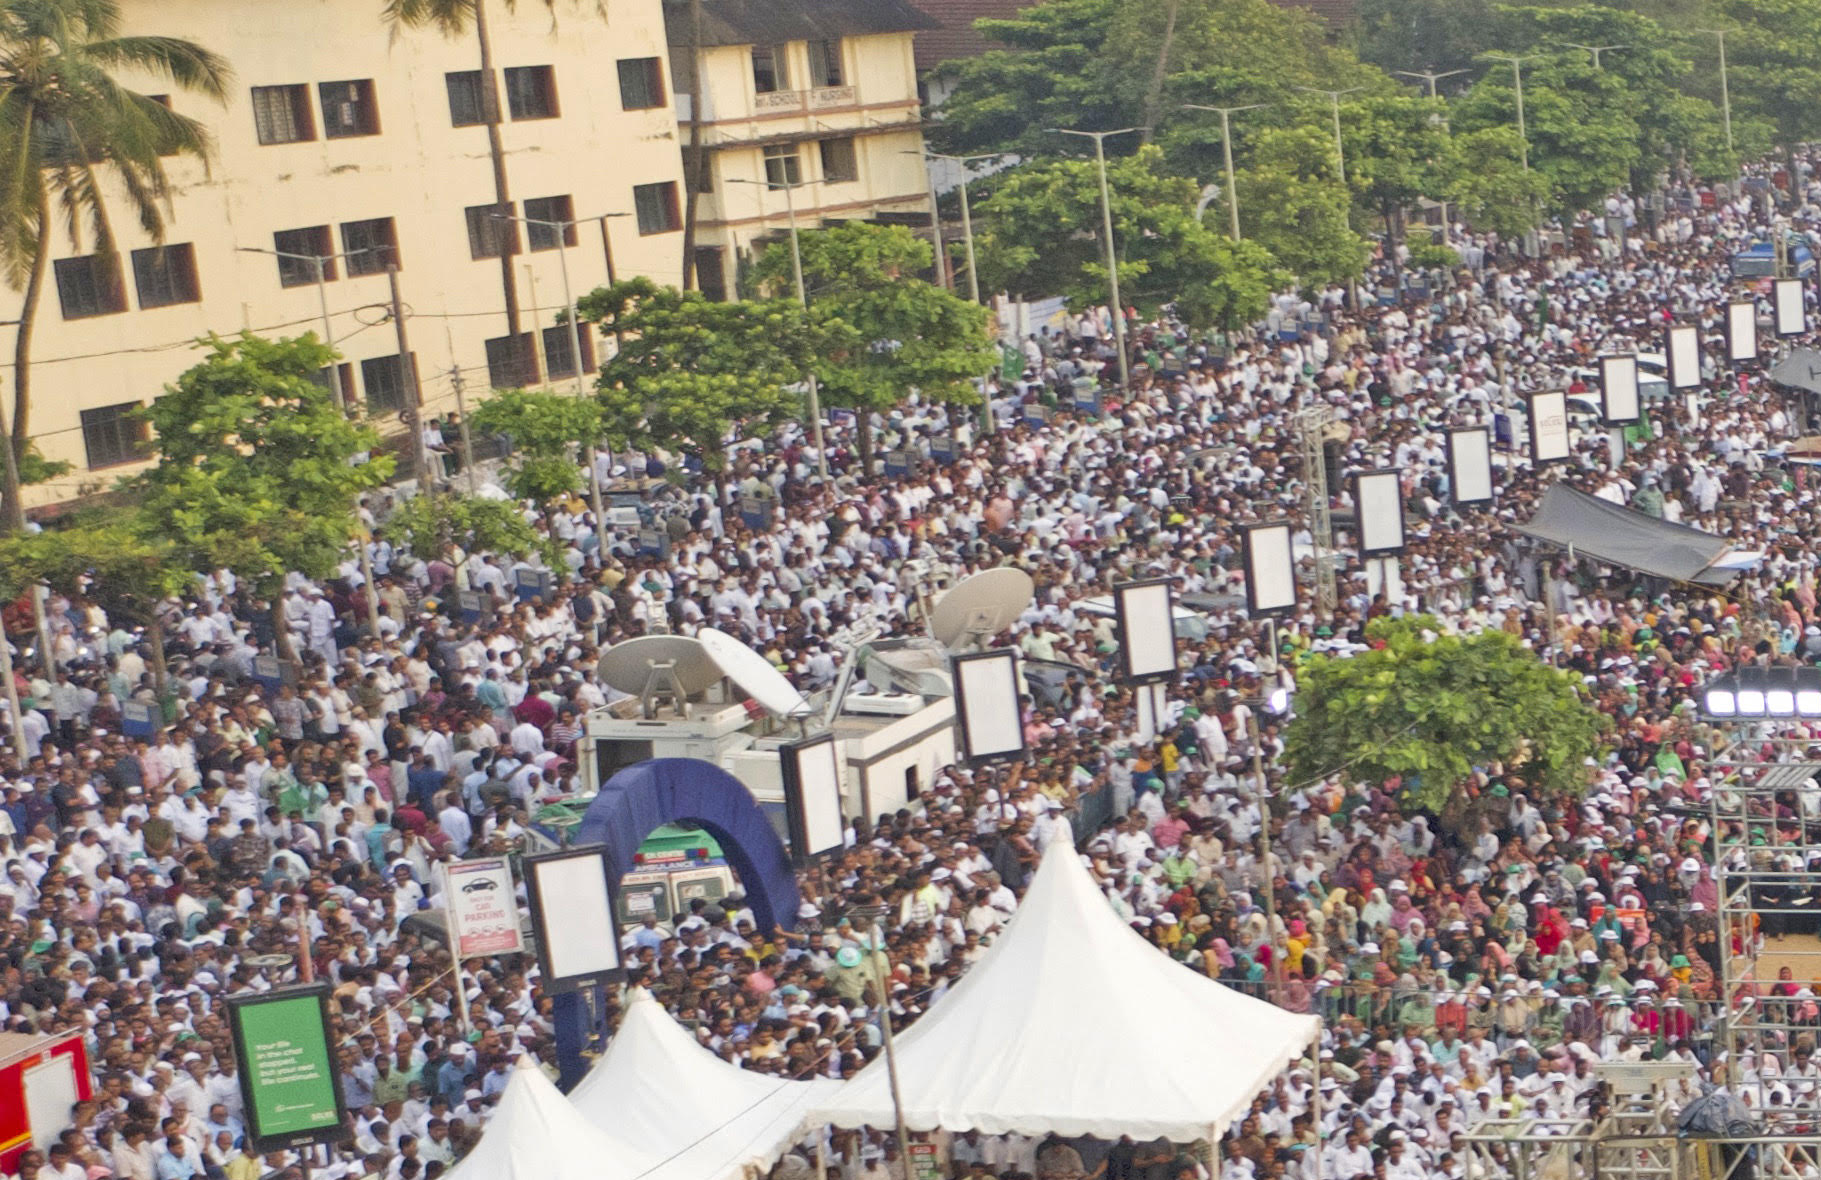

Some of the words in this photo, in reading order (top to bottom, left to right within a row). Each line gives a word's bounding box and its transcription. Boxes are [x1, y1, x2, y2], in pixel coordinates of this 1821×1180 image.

[769, 94, 802, 106] SCHOOL
[635, 860, 695, 871] AMBULANCE
[475, 903, 492, 911] CAR
[465, 910, 506, 922] PARKING
